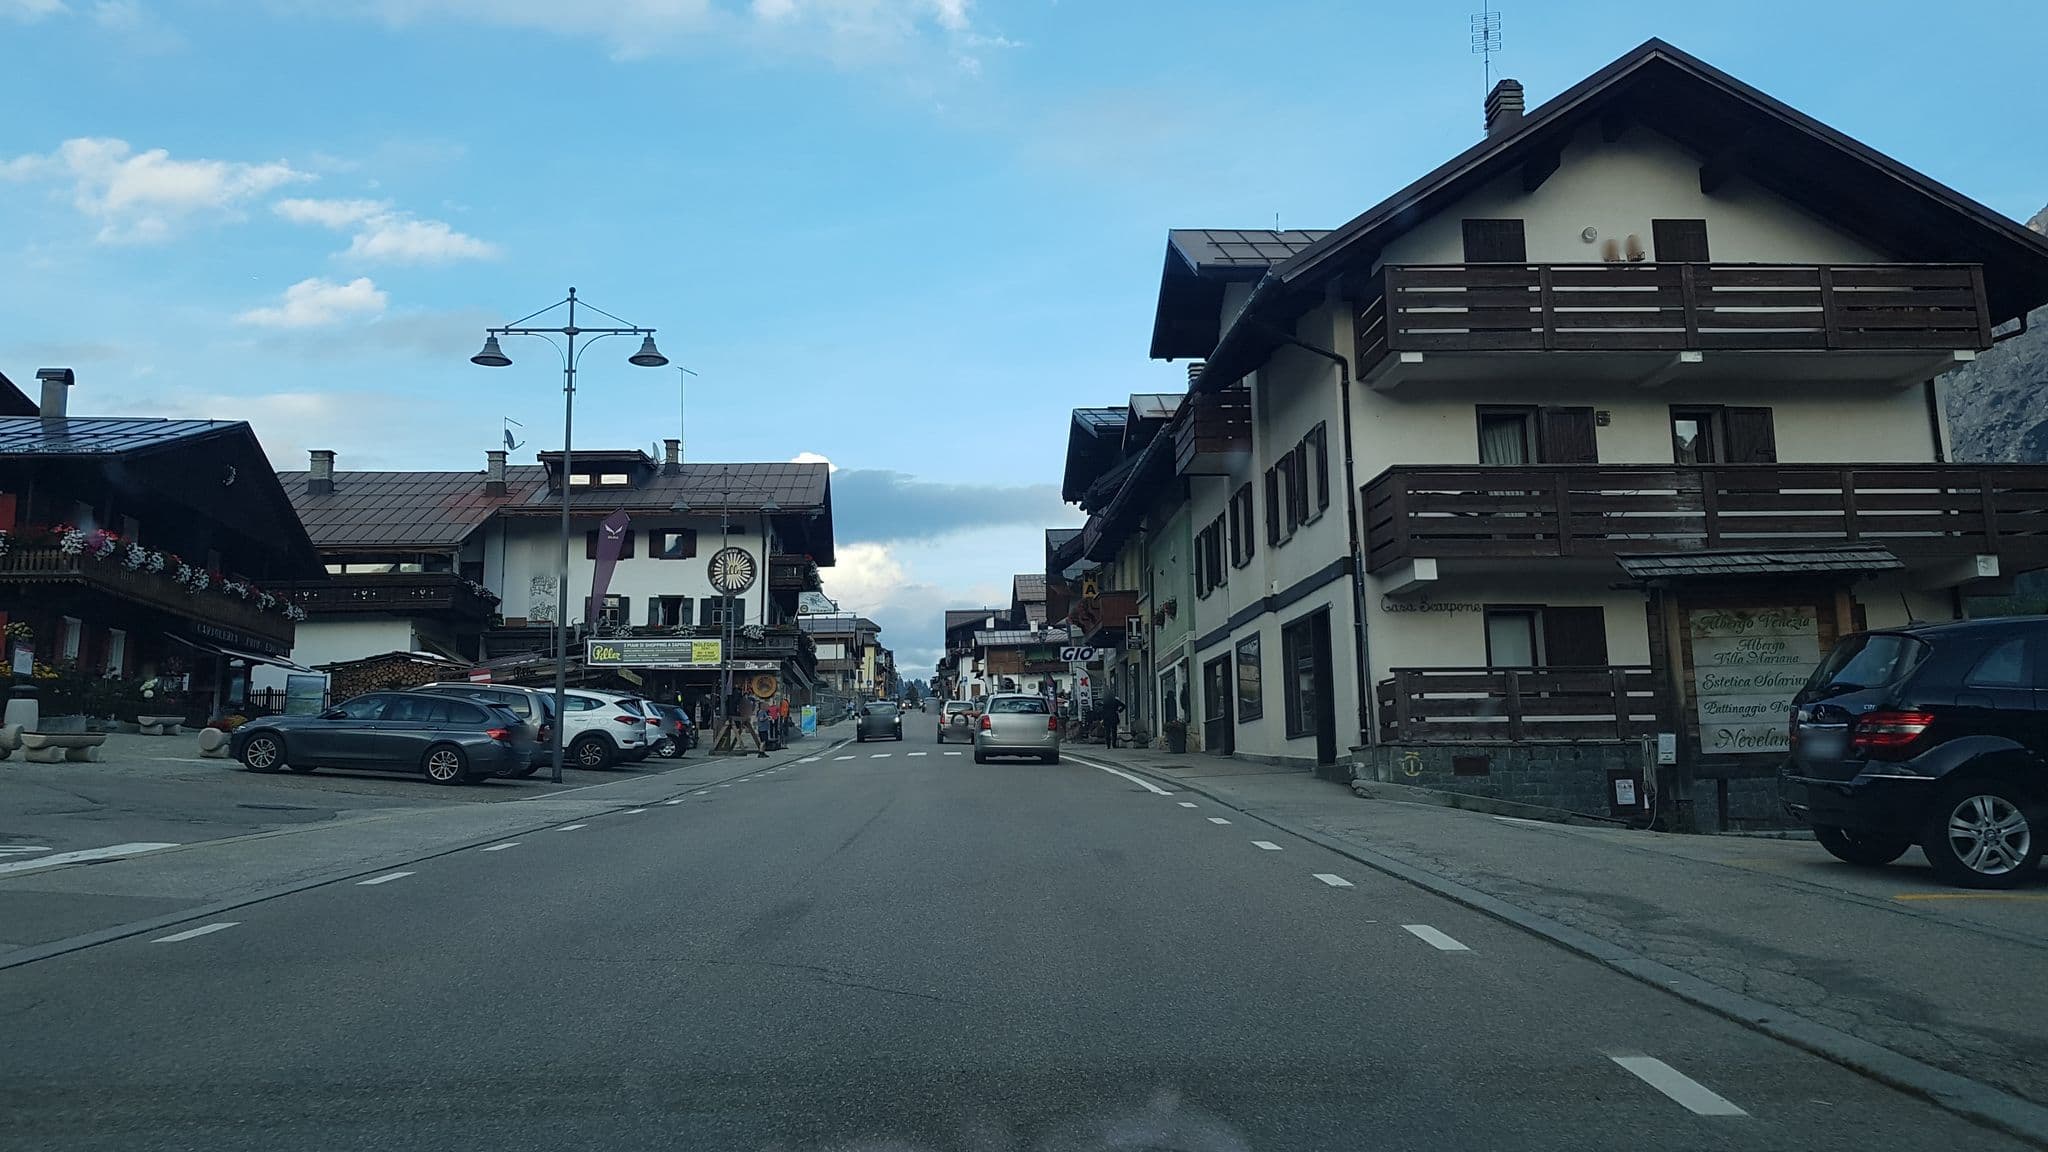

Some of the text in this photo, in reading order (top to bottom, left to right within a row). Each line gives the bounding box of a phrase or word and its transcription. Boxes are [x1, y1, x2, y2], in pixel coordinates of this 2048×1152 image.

[1696, 613, 1811, 634] Albergo Venezia
[592, 645, 621, 661] Piller
[1736, 638, 1786, 654] Albergo
[1713, 651, 1799, 665] Villa Mariana
[1702, 673, 1752, 690] Estetica
[1704, 701, 1768, 717] Pattinaggio
[1714, 727, 1792, 749] Nevelan
